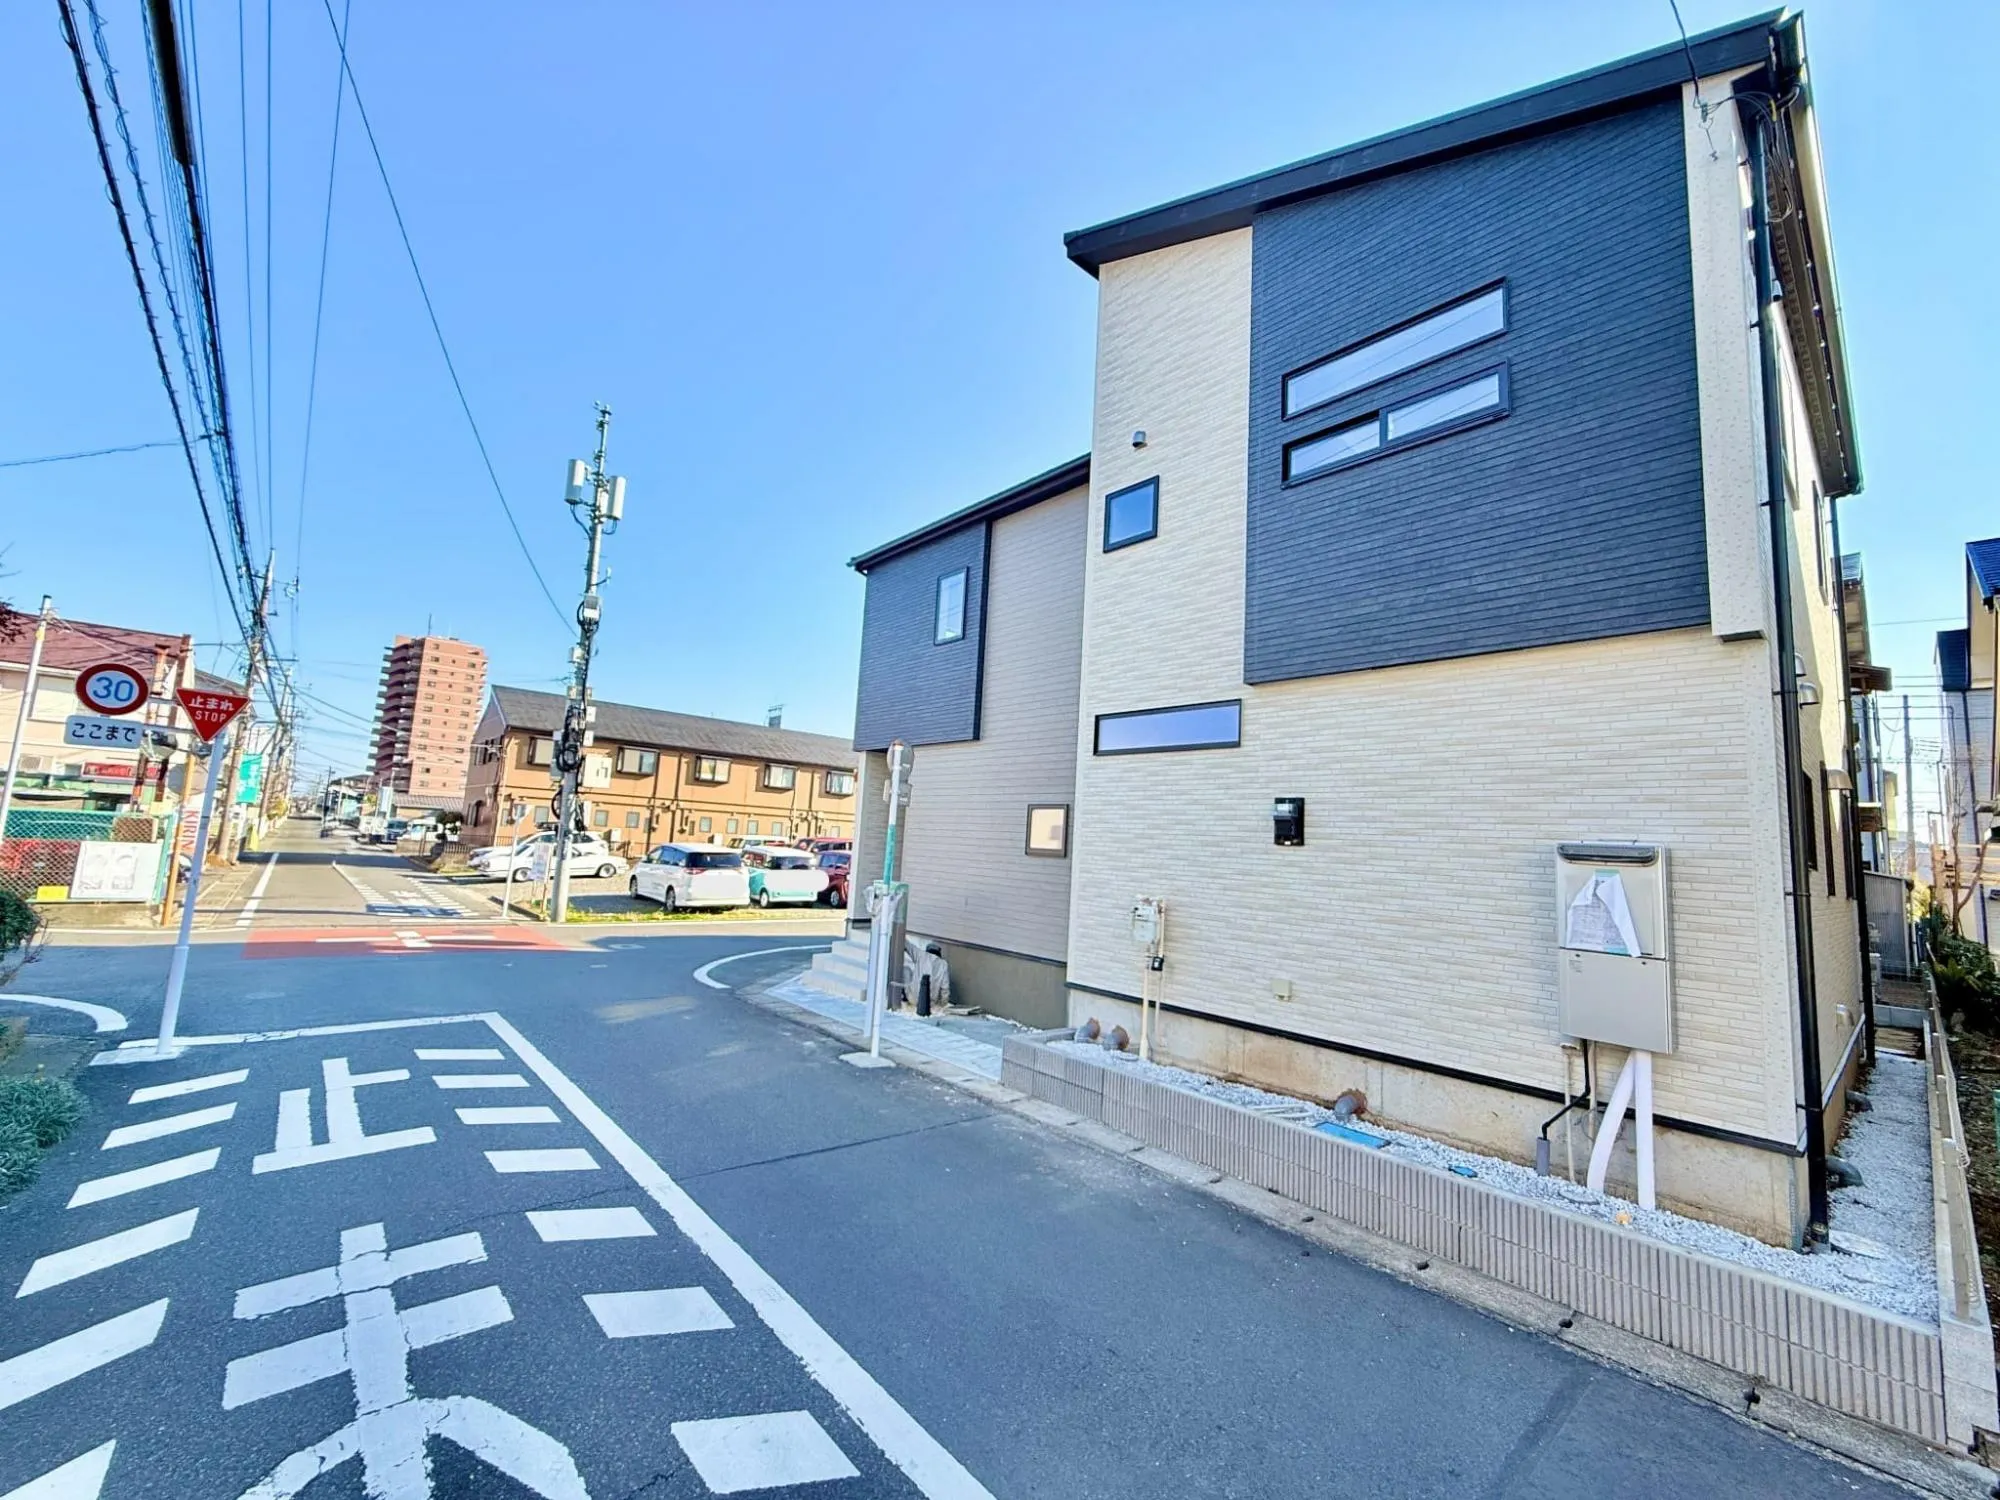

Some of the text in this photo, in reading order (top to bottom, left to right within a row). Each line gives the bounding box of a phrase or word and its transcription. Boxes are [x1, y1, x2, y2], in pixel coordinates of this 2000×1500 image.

[92, 676, 134, 702] 30
[188, 697, 234, 711] 止まれ
[194, 711, 227, 722] STOP
[71, 722, 137, 743] ここまで
[181, 810, 200, 850] KIRIN
